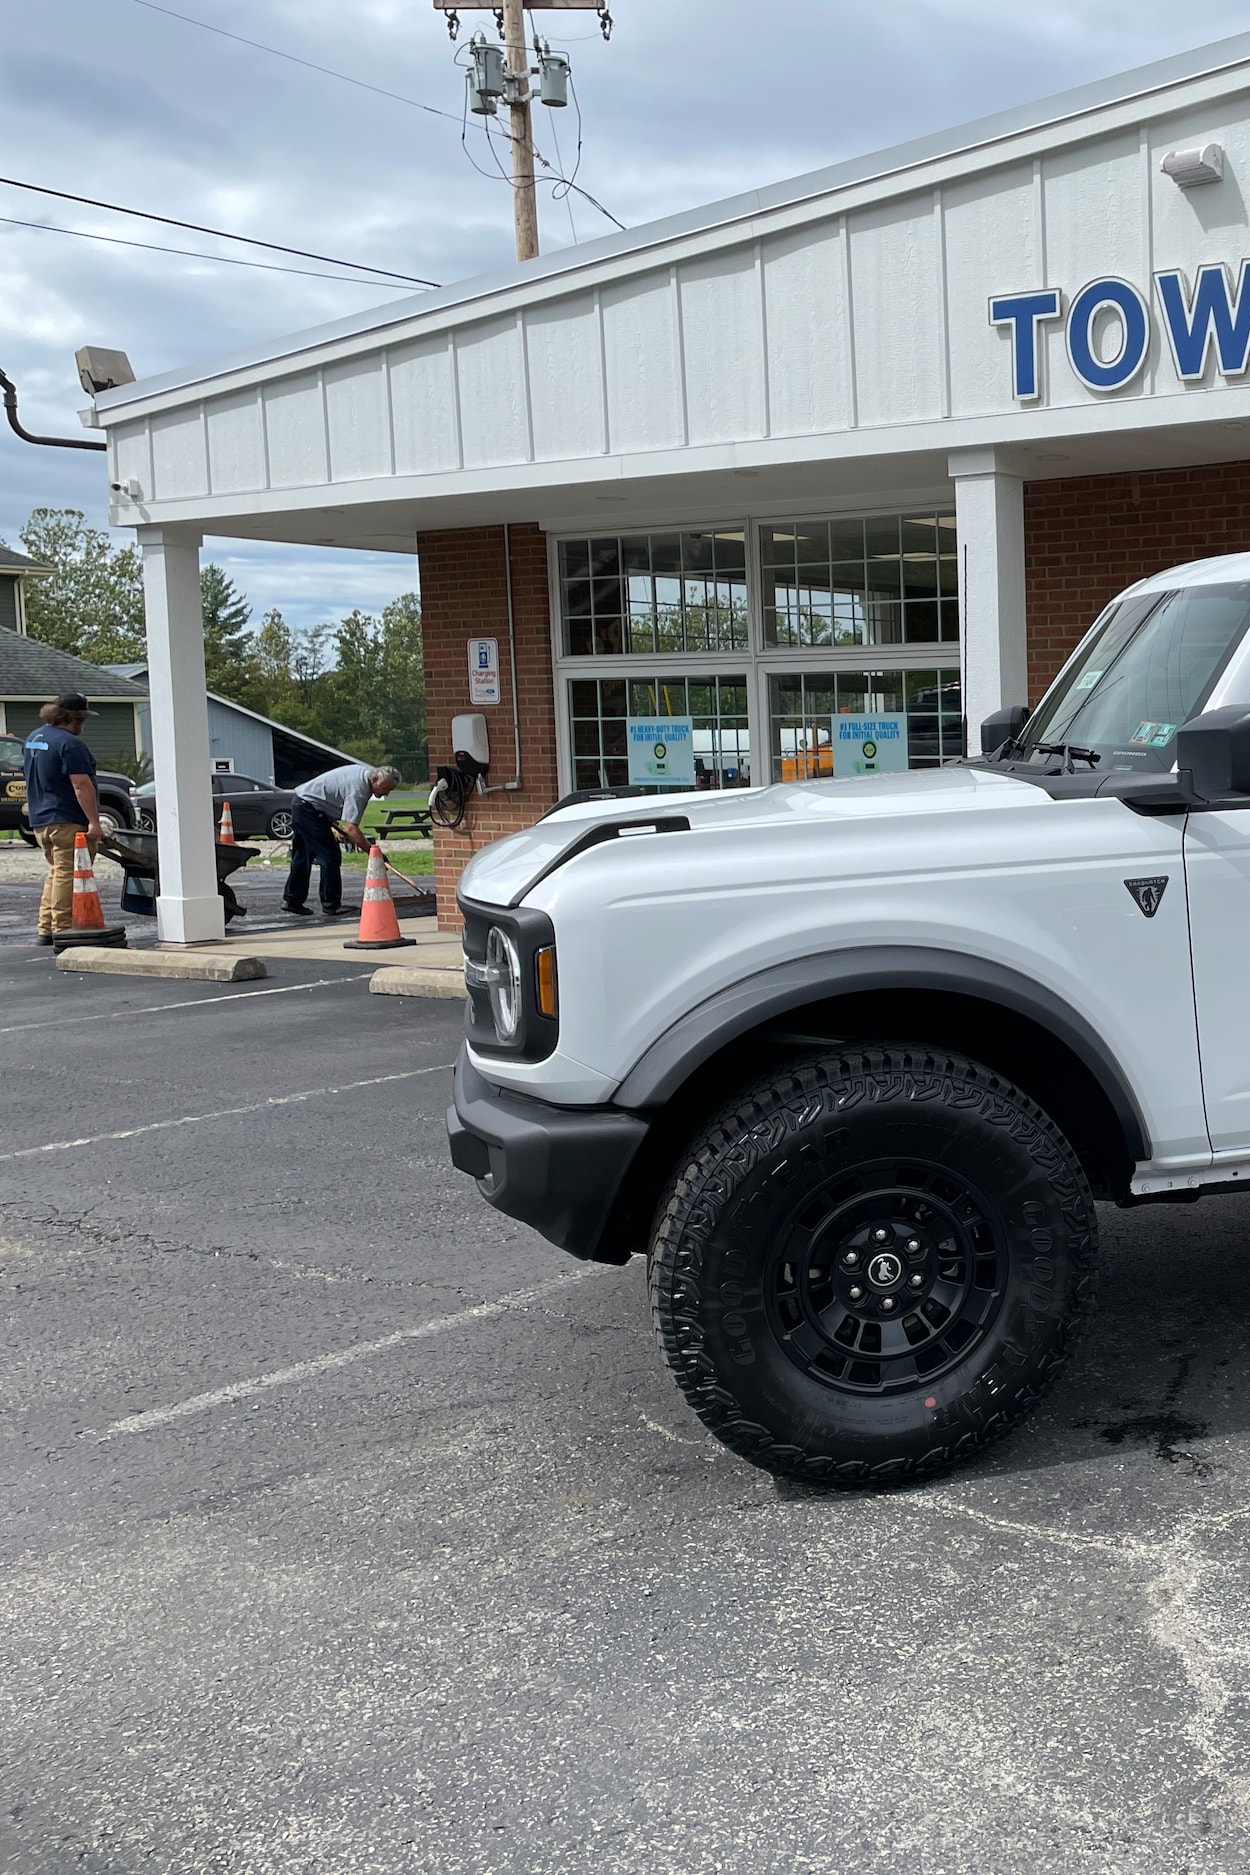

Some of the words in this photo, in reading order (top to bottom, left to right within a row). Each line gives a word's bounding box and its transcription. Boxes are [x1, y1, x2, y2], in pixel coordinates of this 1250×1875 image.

[472, 670, 496, 678] Charging
[637, 725, 670, 733] HEAVY-DUTY
[671, 725, 689, 733] TRUCK
[848, 721, 877, 731] FULL-SIZE
[878, 721, 898, 730] TRUCK
[633, 733, 644, 741] FOR
[645, 733, 663, 741] INITIAL
[664, 733, 686, 742] QUALITY
[839, 731, 851, 740] FOR
[852, 731, 873, 740] INITIAL
[874, 730, 899, 741] QUALITY
[1128, 878, 1166, 887] SASQUATCH
